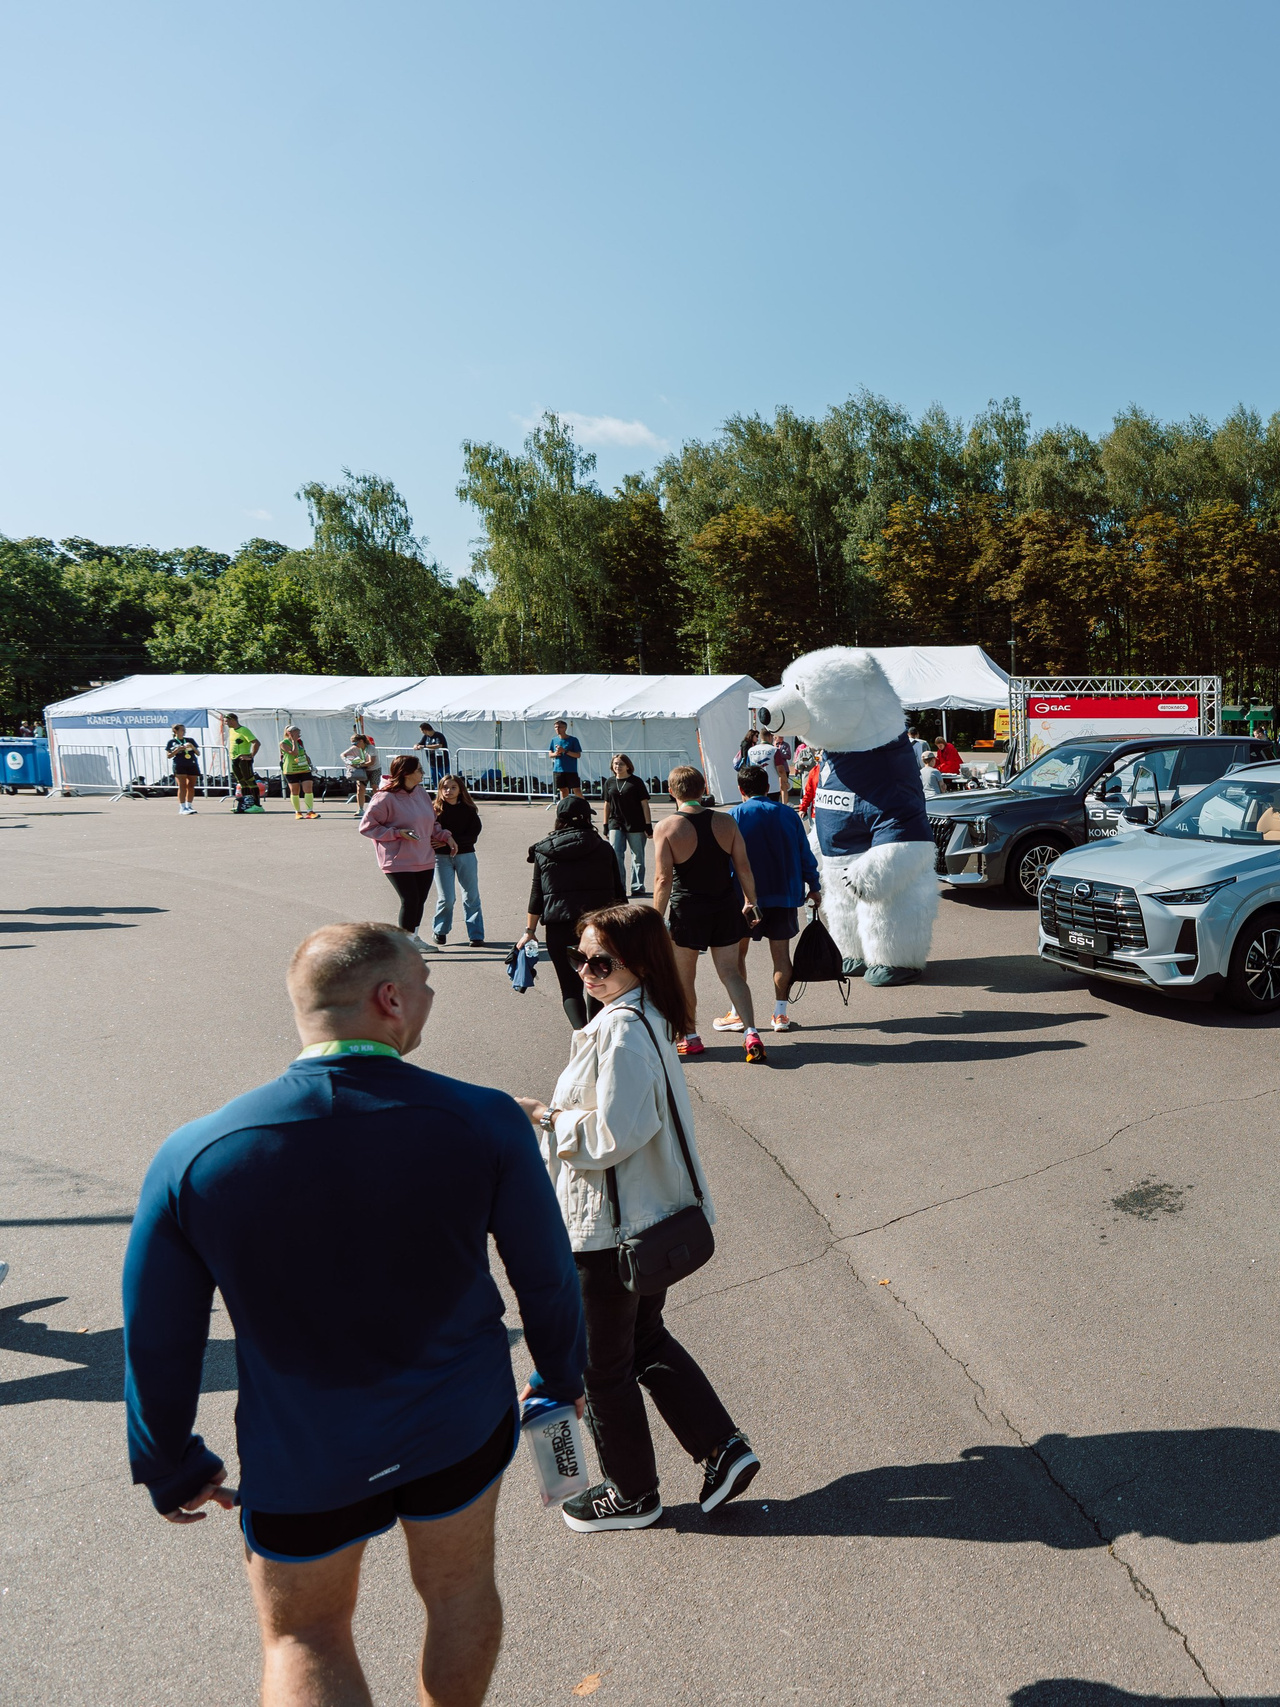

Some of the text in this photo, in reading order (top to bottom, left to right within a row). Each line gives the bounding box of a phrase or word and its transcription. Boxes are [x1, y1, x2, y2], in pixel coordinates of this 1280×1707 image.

[86, 715, 169, 725] КАМЕРА ХРАНЕНИЯ
[1088, 809, 1121, 820] GS
[1088, 828, 1119, 837] КОМФ
[1068, 935, 1095, 948] GS4
[559, 1420, 580, 1477] NUTRITION
[552, 1436, 572, 1478] APPLIED
